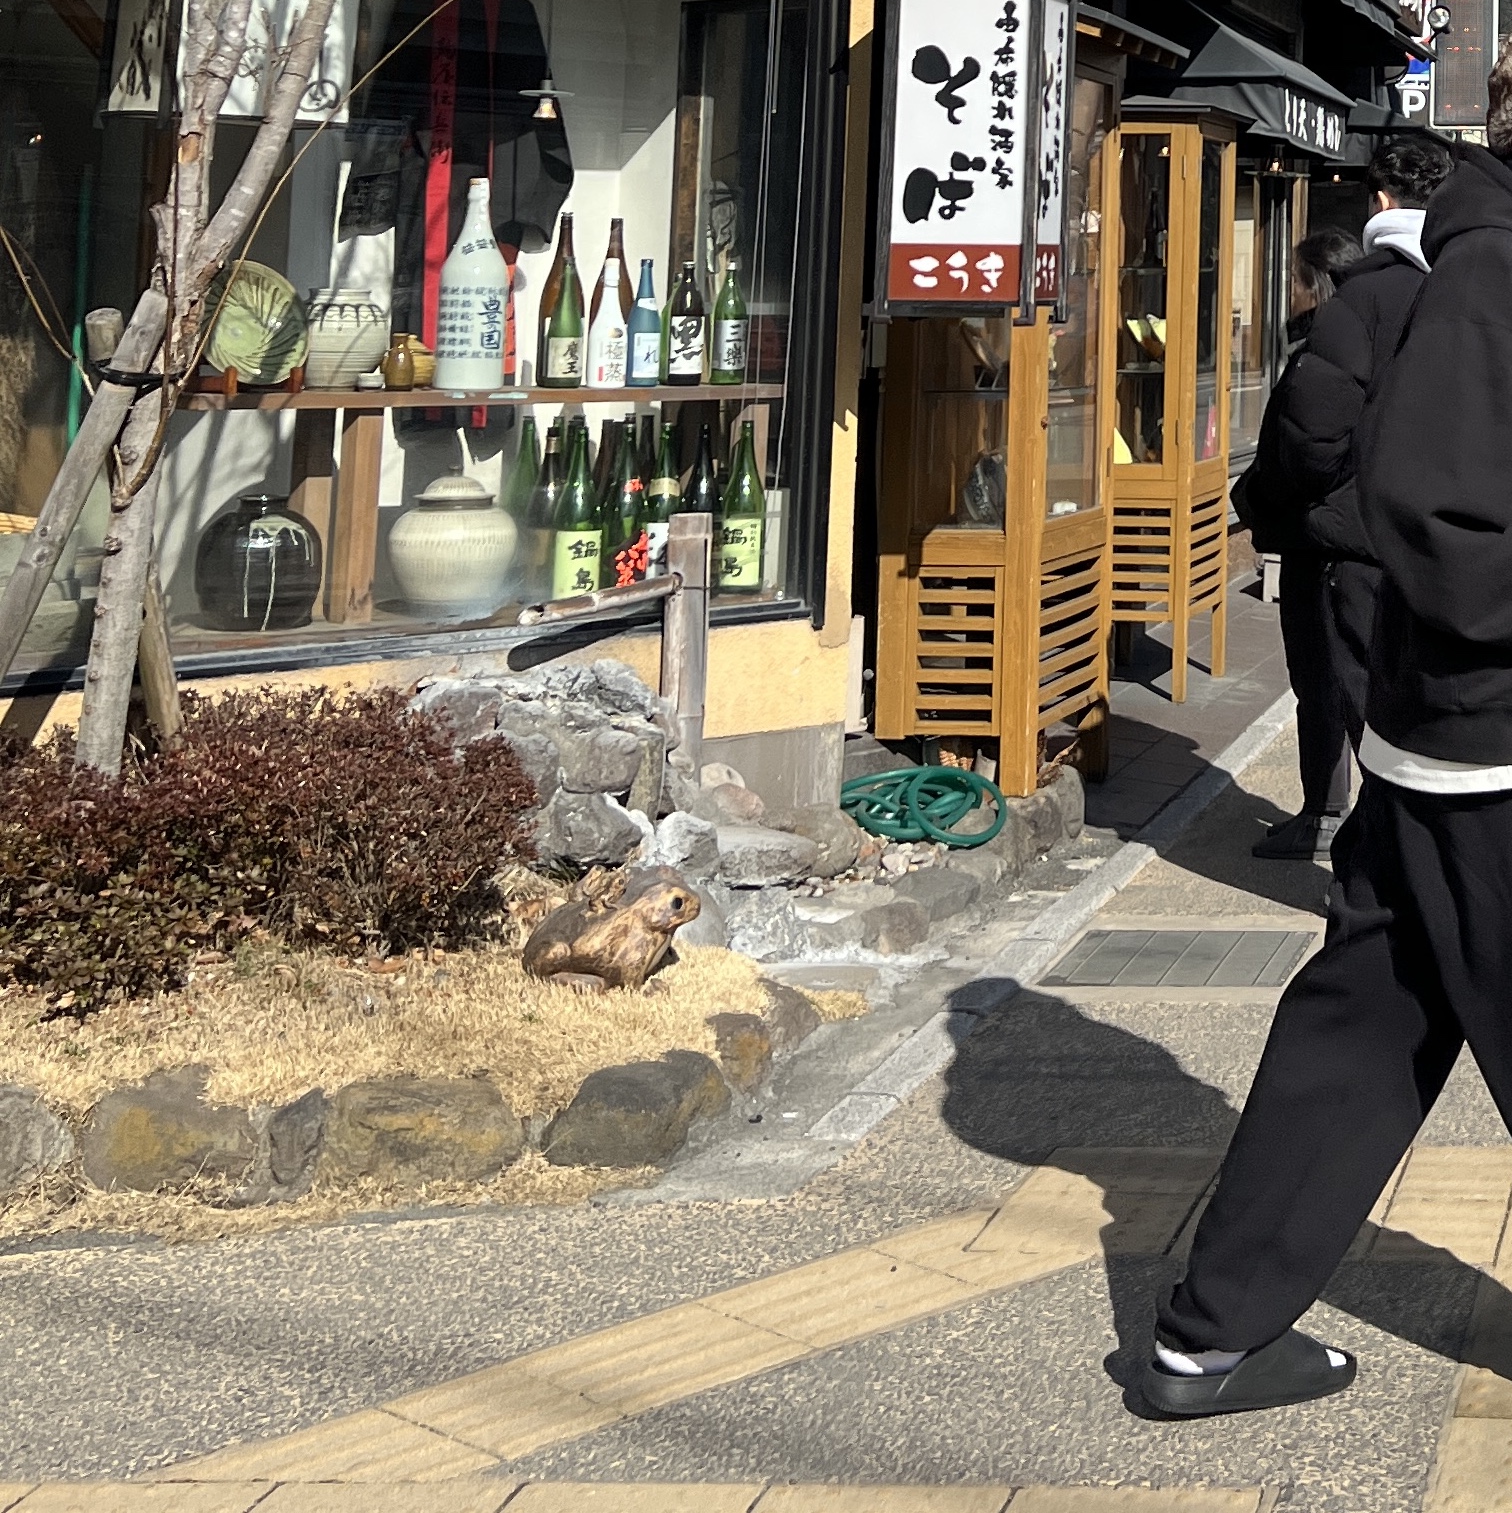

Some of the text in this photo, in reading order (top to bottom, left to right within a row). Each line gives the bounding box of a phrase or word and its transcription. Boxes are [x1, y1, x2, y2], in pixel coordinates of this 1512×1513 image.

[1402, 89, 1427, 119] P
[902, 44, 987, 224] そば
[908, 251, 1005, 294] こうき
[562, 340, 579, 375] 魔王
[567, 538, 600, 592] 鍋島
